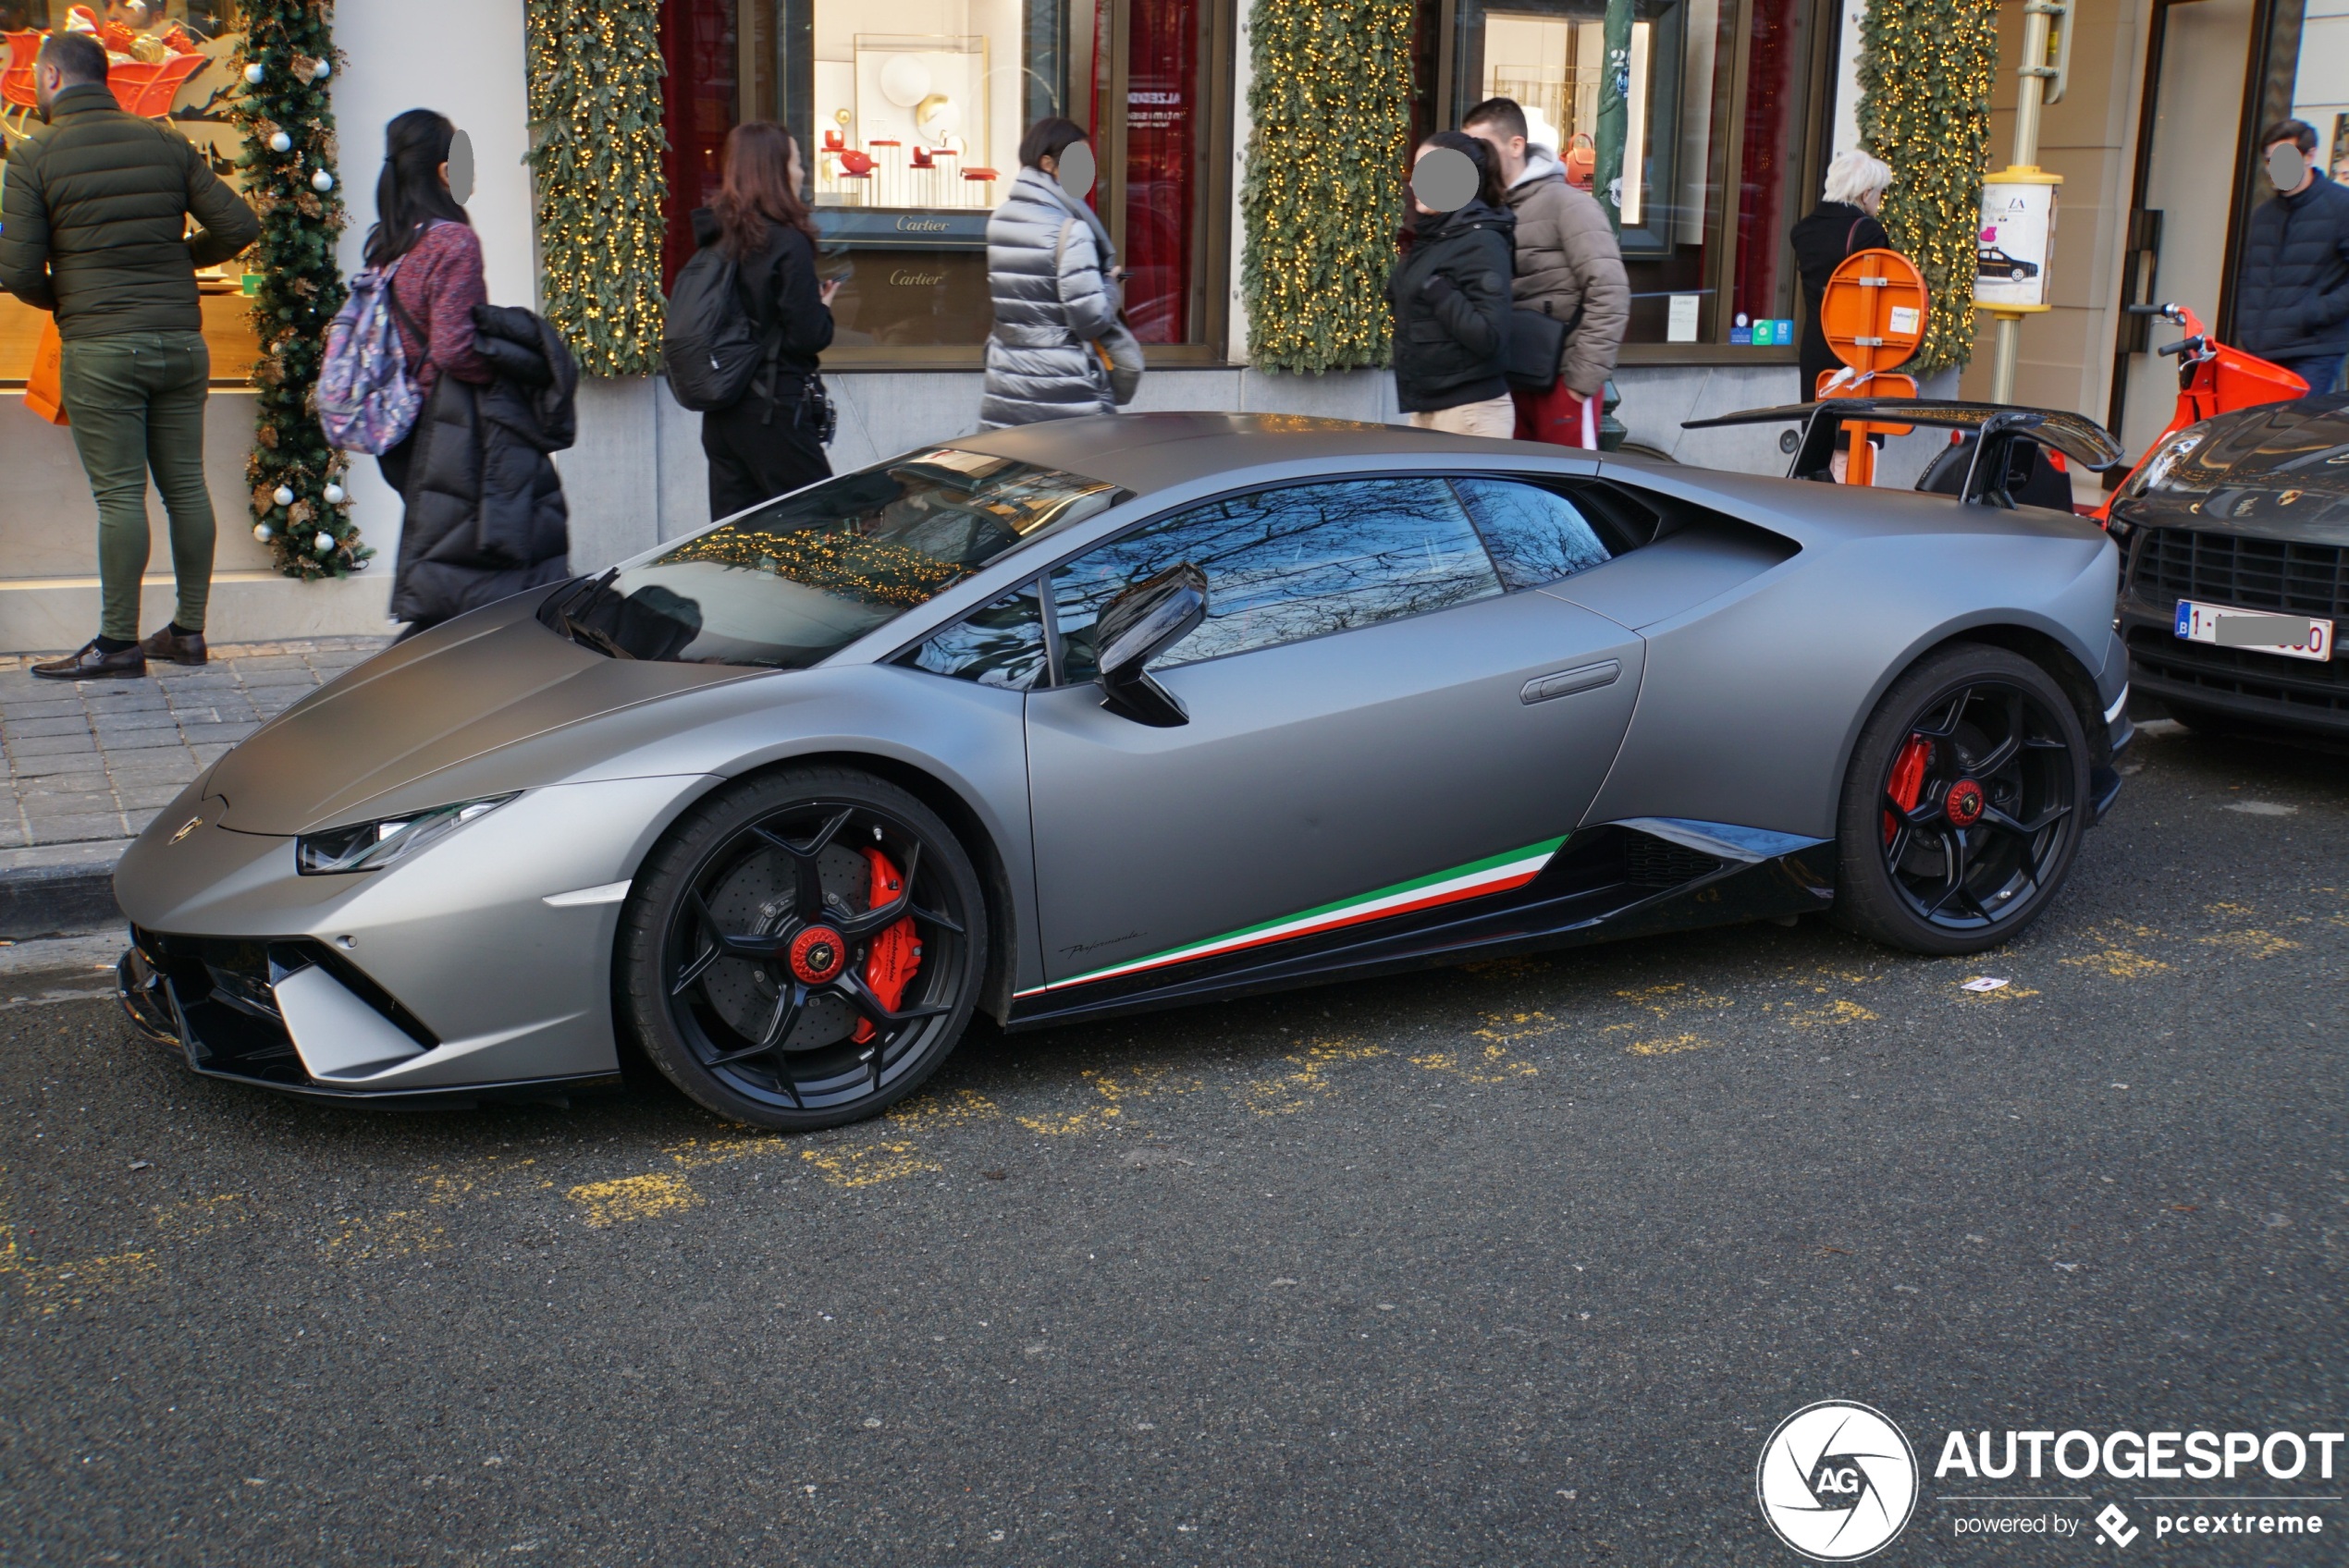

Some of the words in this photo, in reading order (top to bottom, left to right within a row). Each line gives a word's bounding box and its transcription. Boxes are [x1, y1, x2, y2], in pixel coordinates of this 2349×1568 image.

[895, 214, 950, 232] Cartier
[889, 268, 943, 287] Cartier
[2179, 621, 2188, 634] B
[1058, 930, 1148, 960] Performante
